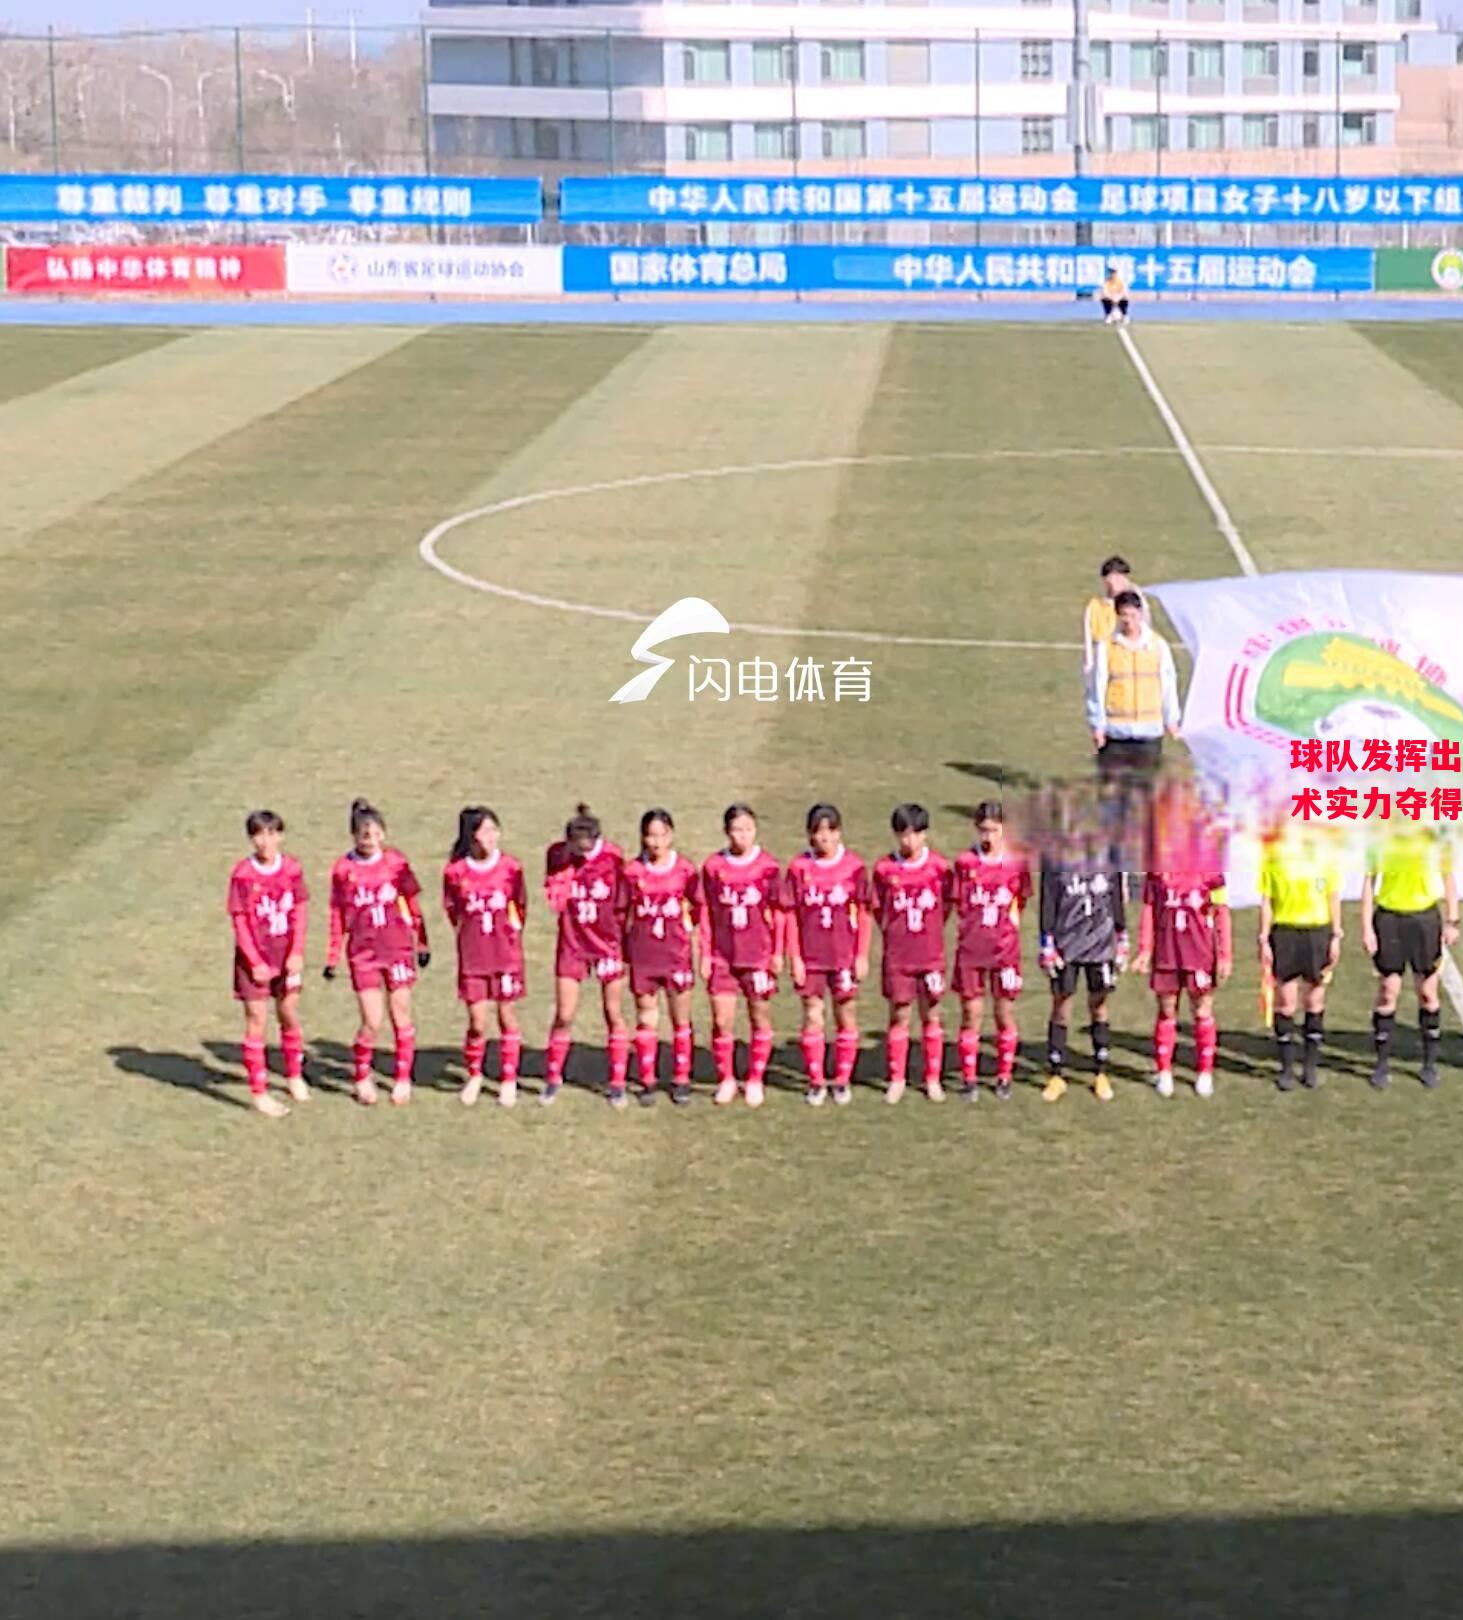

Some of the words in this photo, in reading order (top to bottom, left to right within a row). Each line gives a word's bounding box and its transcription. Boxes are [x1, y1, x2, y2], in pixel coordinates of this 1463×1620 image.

[57, 184, 183, 216] 尊重裁判
[203, 184, 329, 216] 尊重对手
[349, 186, 472, 218] 尊重规则
[648, 184, 1078, 215] 中华人民共和国第十五届运动会
[46, 257, 242, 281] 弘扬中华体育精神
[609, 252, 787, 285] 国家体育总局
[893, 254, 1317, 287] 中华人民共和国第十五届运动会
[1084, 896, 1092, 916] 1
